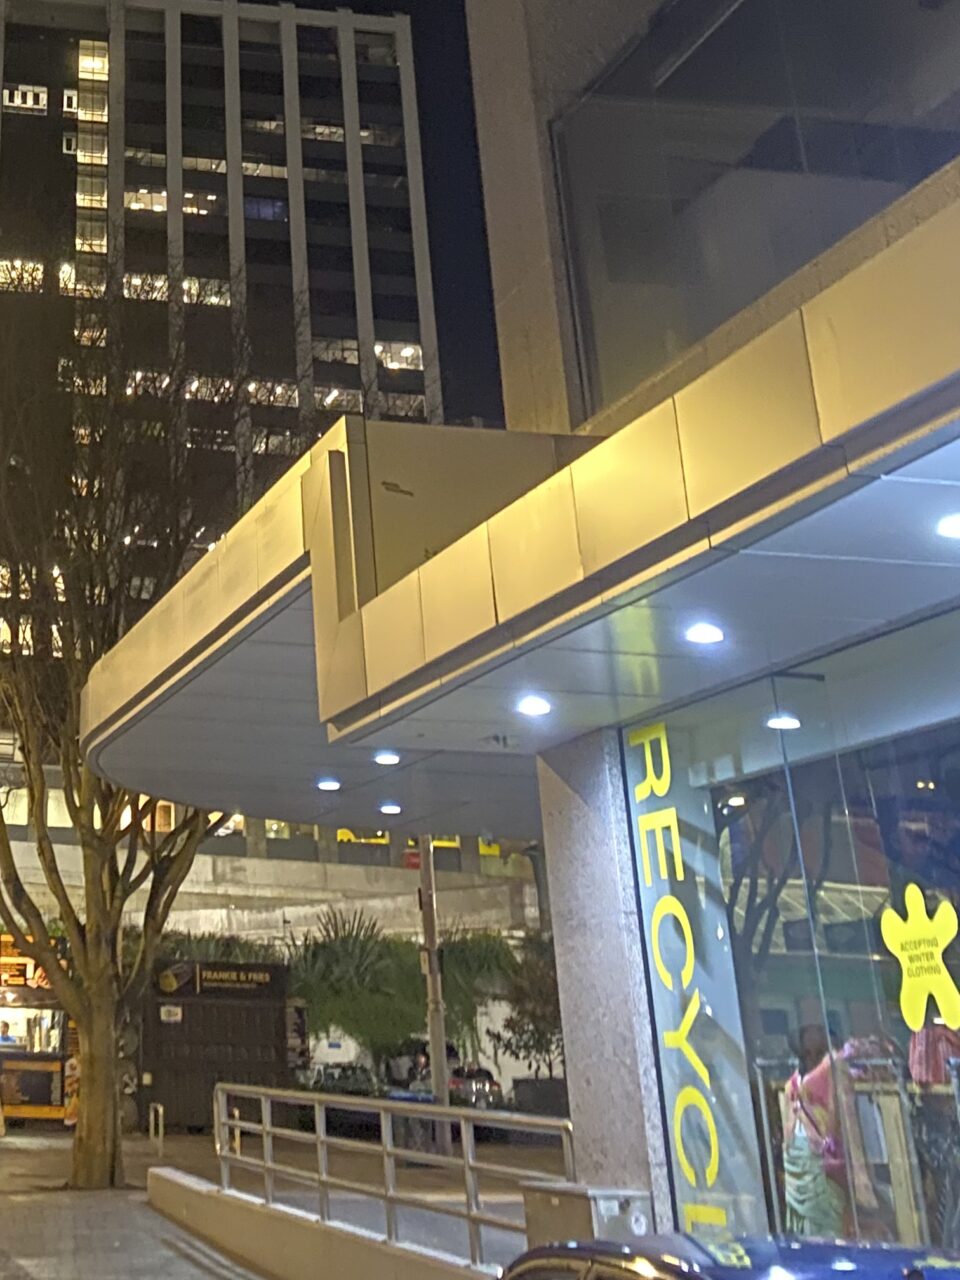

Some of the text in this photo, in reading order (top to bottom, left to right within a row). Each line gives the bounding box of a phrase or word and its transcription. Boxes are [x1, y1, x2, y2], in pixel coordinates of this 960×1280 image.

[900, 937, 939, 952] ACCEPTING
[908, 951, 935, 964] WINTER
[202, 971, 237, 980] FRANKIE
[907, 964, 941, 978] CLOTHING
